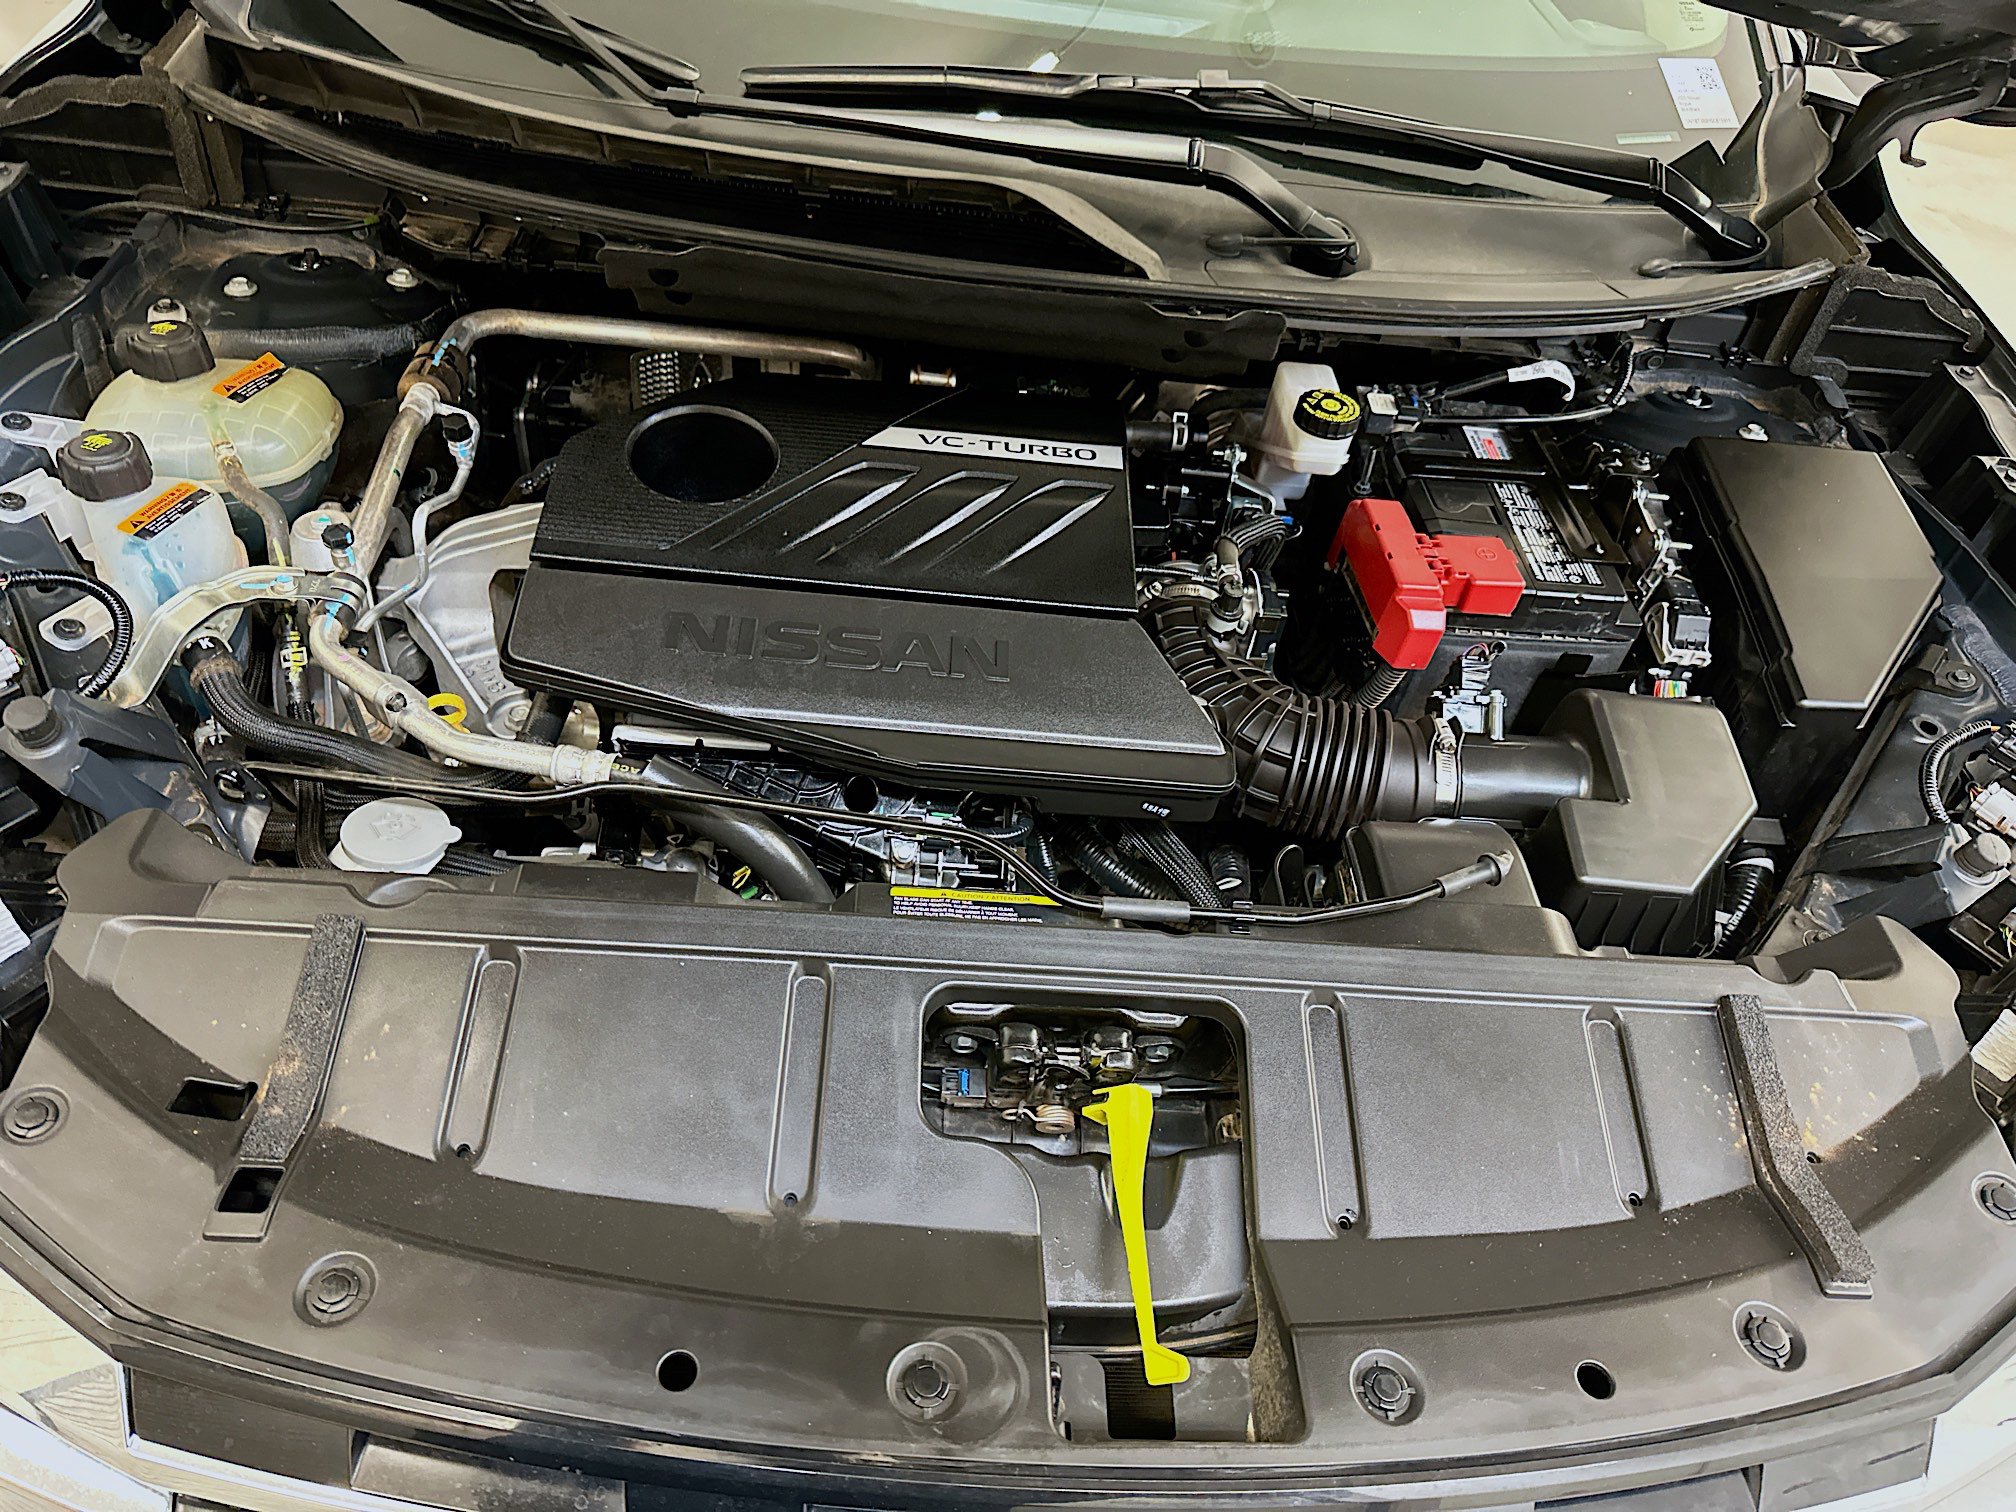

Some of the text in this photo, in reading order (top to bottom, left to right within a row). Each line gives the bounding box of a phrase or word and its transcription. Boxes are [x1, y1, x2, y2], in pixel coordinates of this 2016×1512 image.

[918, 433, 1097, 461] VC-TURBO
[665, 611, 1010, 682] NISSAN
[952, 892, 984, 900] CAUTION
